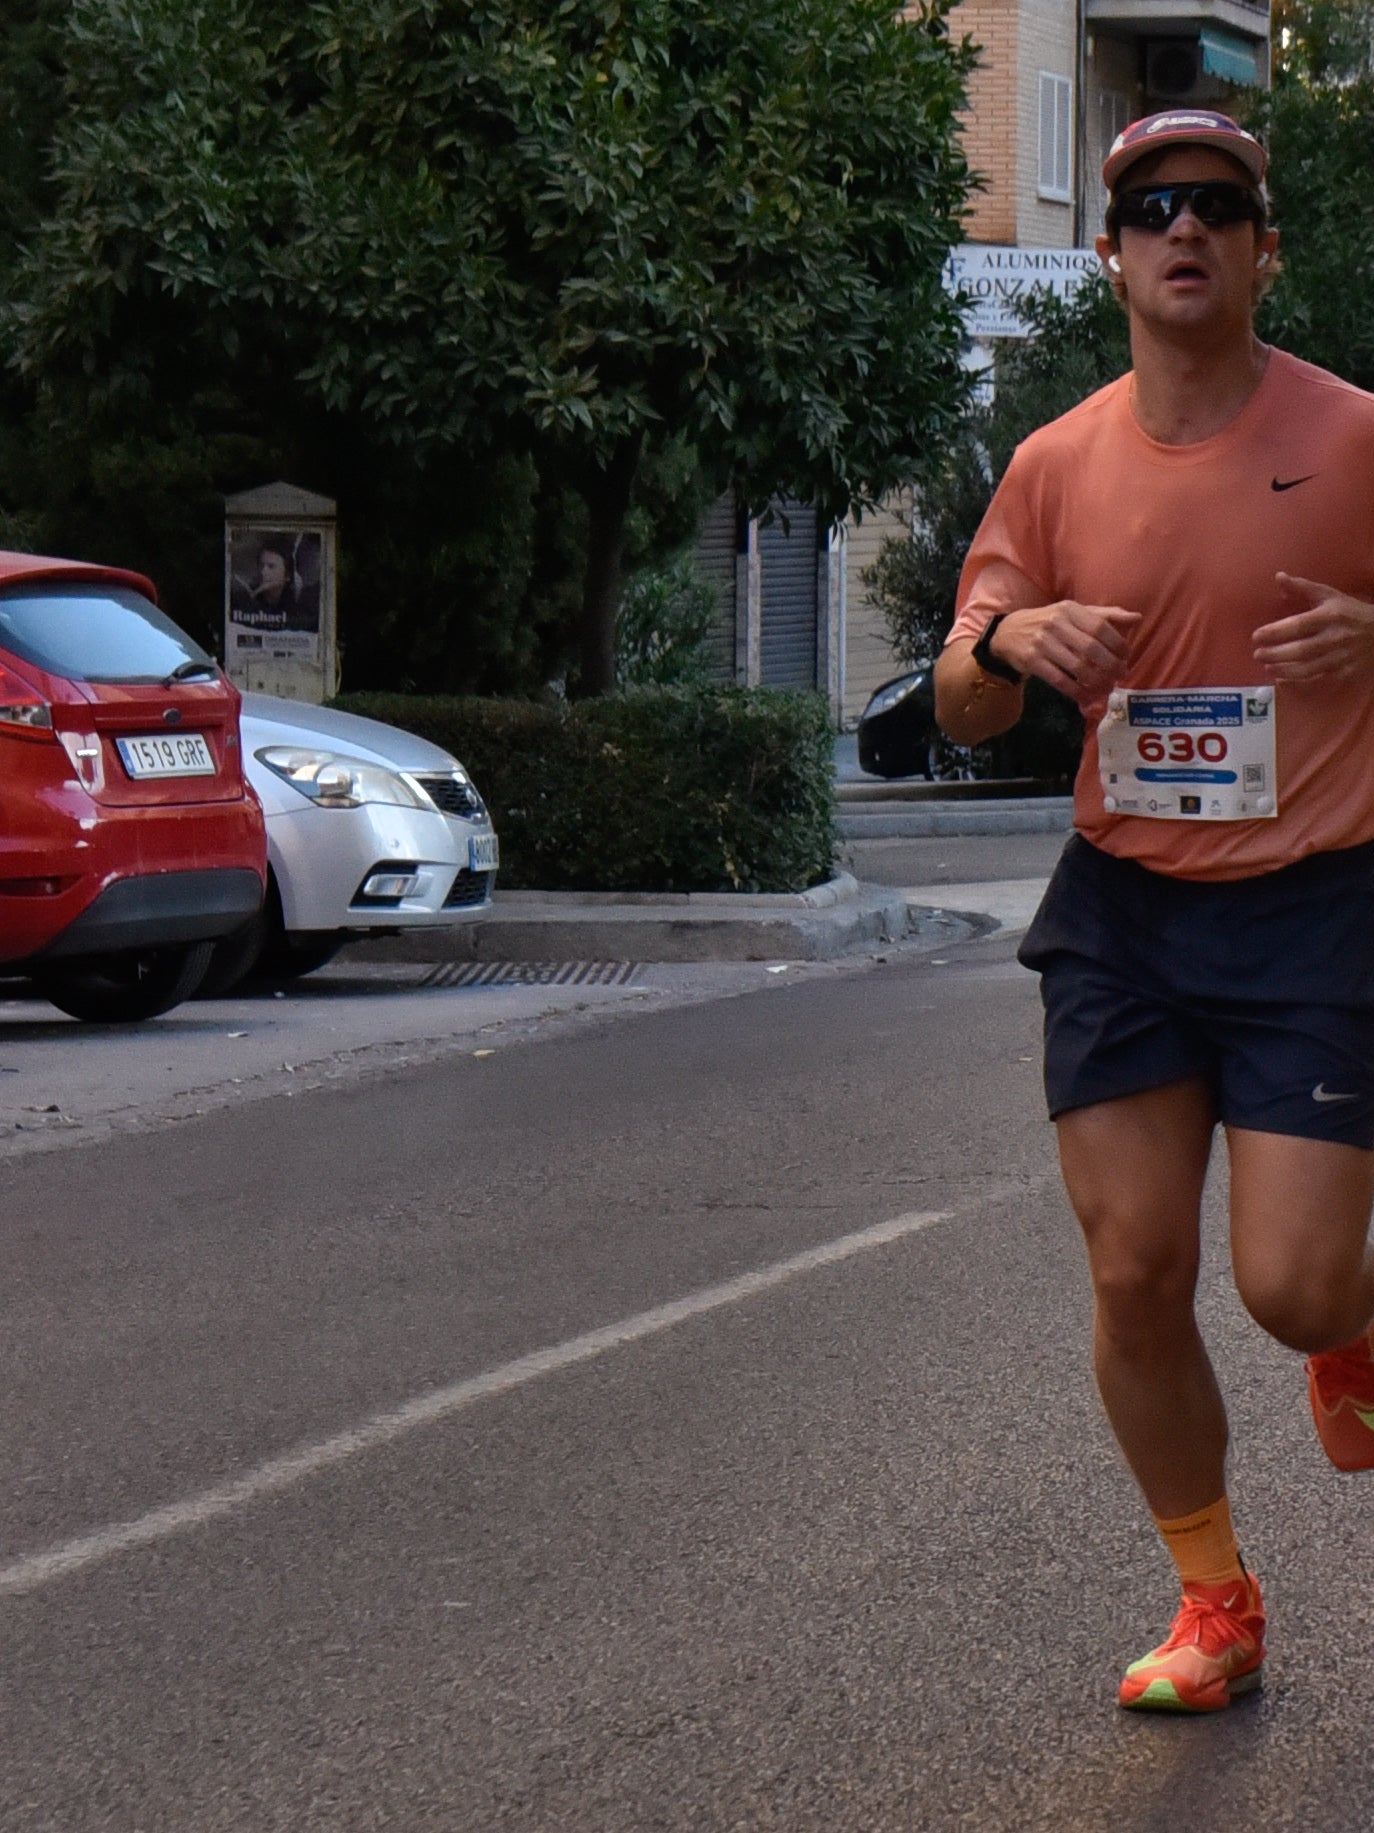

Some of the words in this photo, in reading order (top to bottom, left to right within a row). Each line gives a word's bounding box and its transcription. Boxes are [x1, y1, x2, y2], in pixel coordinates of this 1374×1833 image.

[982, 252, 1098, 271] ALUMINIOS
[957, 276, 1079, 299] GONZALE
[232, 609, 287, 625] Raphael
[1130, 695, 1185, 704] CARRERA
[1187, 695, 1239, 703] MARCHA
[1152, 705, 1213, 714] SOLIDARIA
[1133, 717, 1172, 726] ASPACE
[1173, 717, 1215, 726] Granada
[1216, 716, 1241, 726] 2025
[131, 740, 176, 770] 1519
[176, 738, 206, 766] GRF
[1137, 732, 1228, 763] 630
